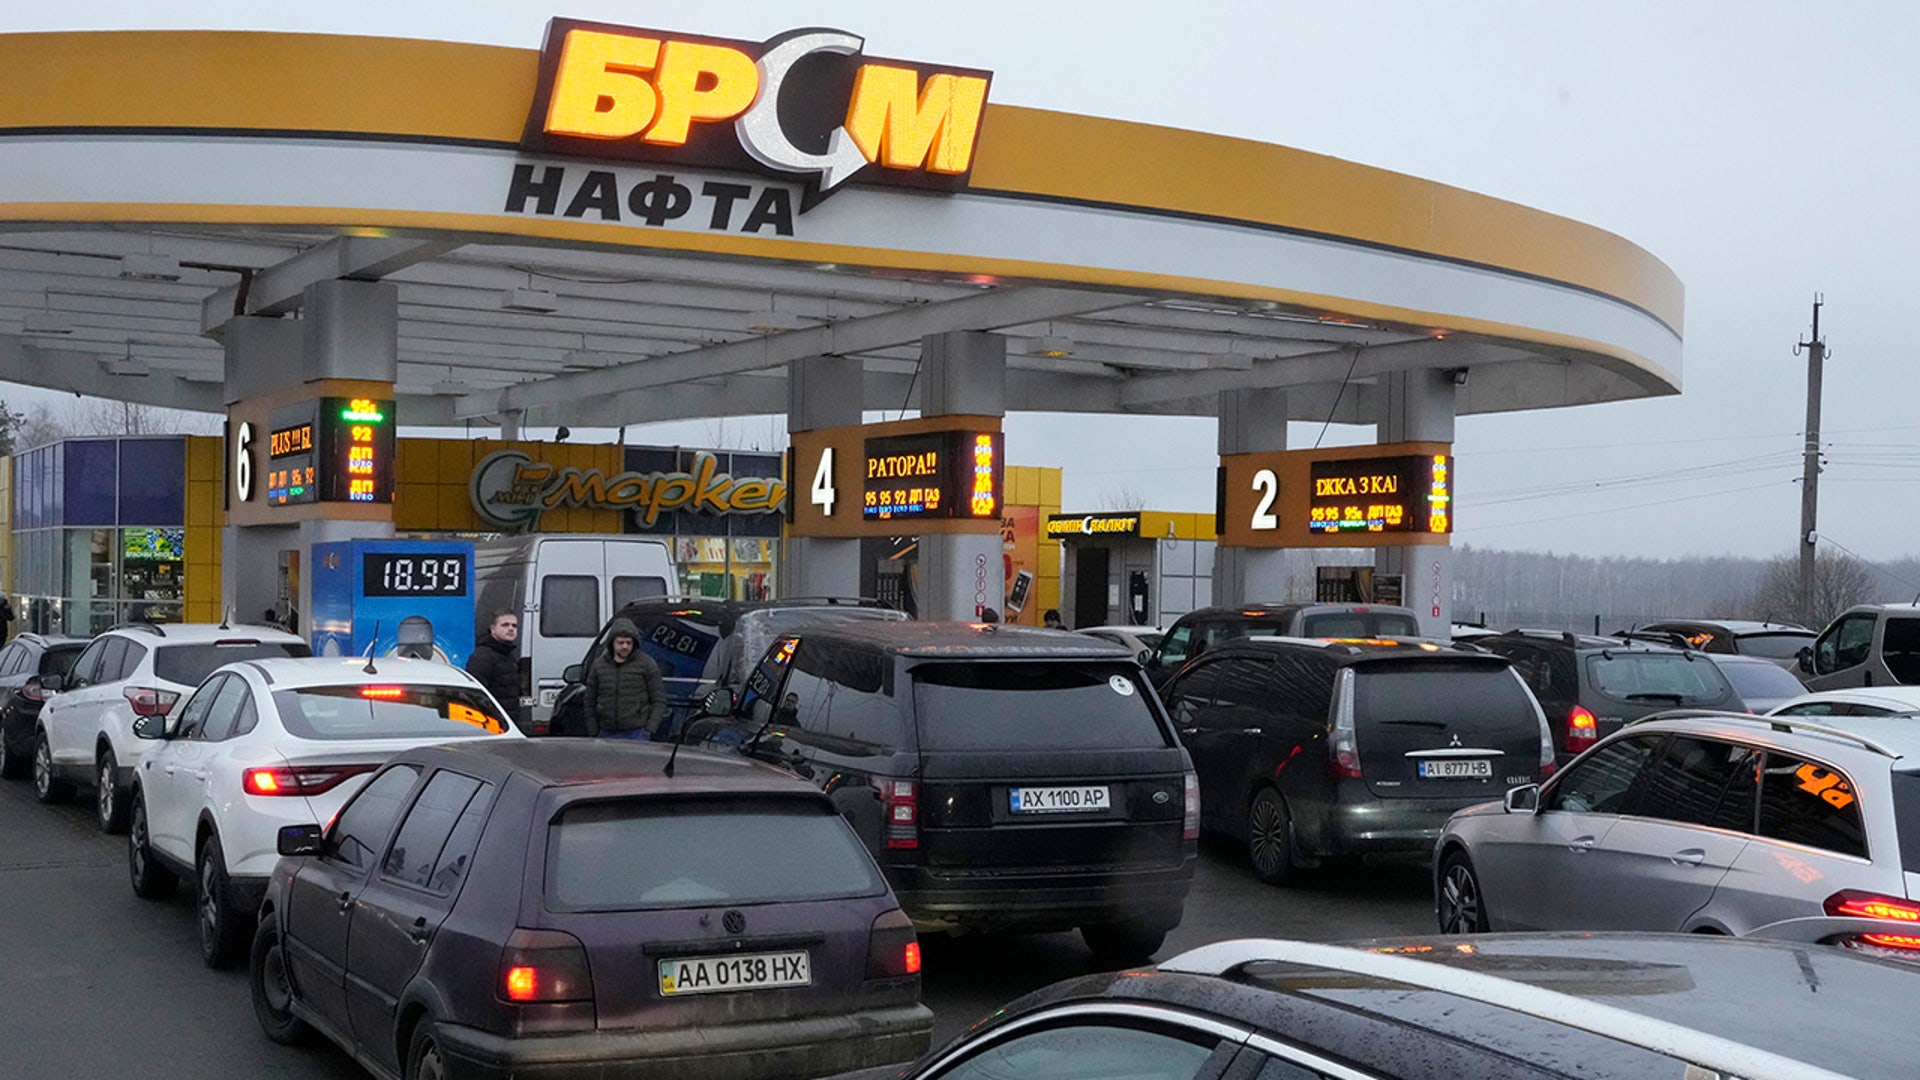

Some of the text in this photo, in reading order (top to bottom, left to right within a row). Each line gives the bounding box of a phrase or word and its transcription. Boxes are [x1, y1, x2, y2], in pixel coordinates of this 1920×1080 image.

[543, 29, 988, 185] БРСМ
[504, 164, 794, 236] НАФТА
[352, 426, 372, 441] 92
[237, 422, 251, 501] 6
[867, 452, 937, 478] РАТОРА!!
[811, 447, 835, 516] 4
[865, 488, 940, 506] 95 95 92 ДП ГАЗ
[1251, 469, 1277, 529] 2
[1090, 518, 1138, 532] ВАЛЮТ
[1311, 508, 1324, 521] 95
[1325, 507, 1338, 520] 95
[1367, 505, 1383, 519] ДП
[1385, 505, 1403, 518] ГАЗ
[383, 559, 461, 591] 18.99
[1427, 763, 1488, 776] AI 8777 HB
[1023, 789, 1104, 807] AX 1100 AP
[677, 956, 803, 989] AA 0138 HX
